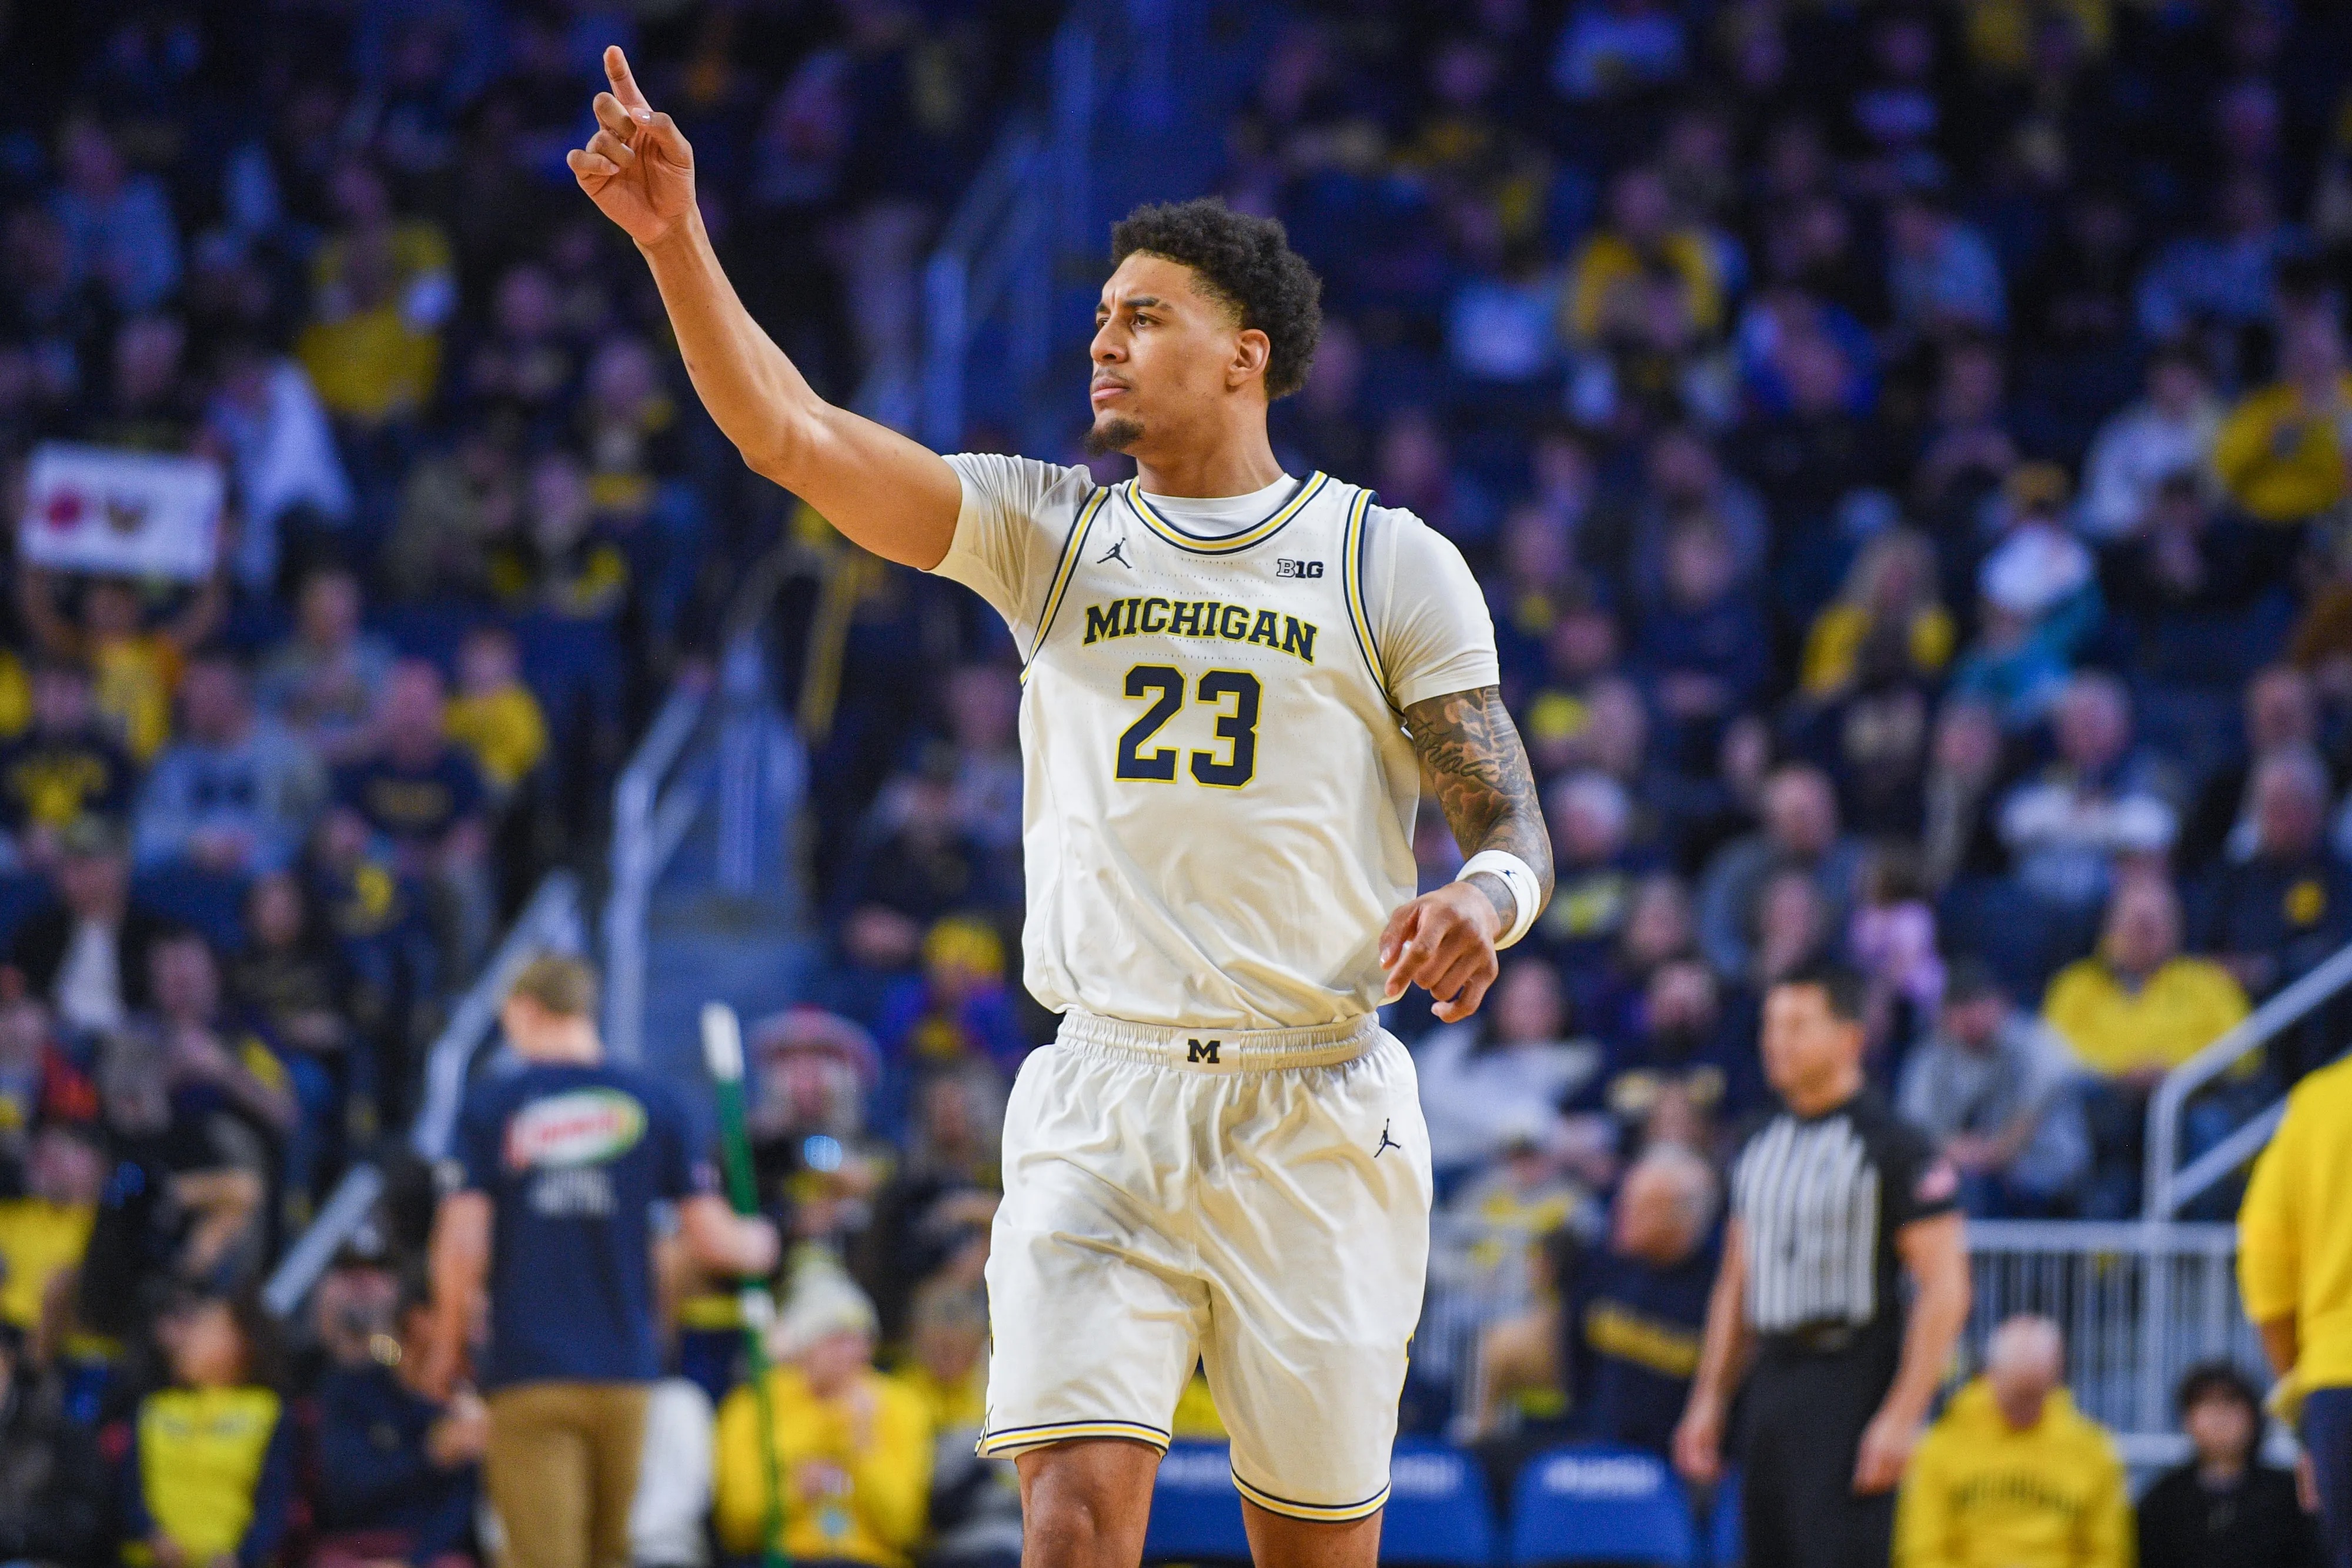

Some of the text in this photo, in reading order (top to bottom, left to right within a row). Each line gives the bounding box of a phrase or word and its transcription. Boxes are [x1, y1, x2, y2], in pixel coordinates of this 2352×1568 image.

[1083, 597, 1318, 665] MICHIGAN
[1114, 663, 1263, 790] 23
[1187, 1039, 1220, 1064] M
